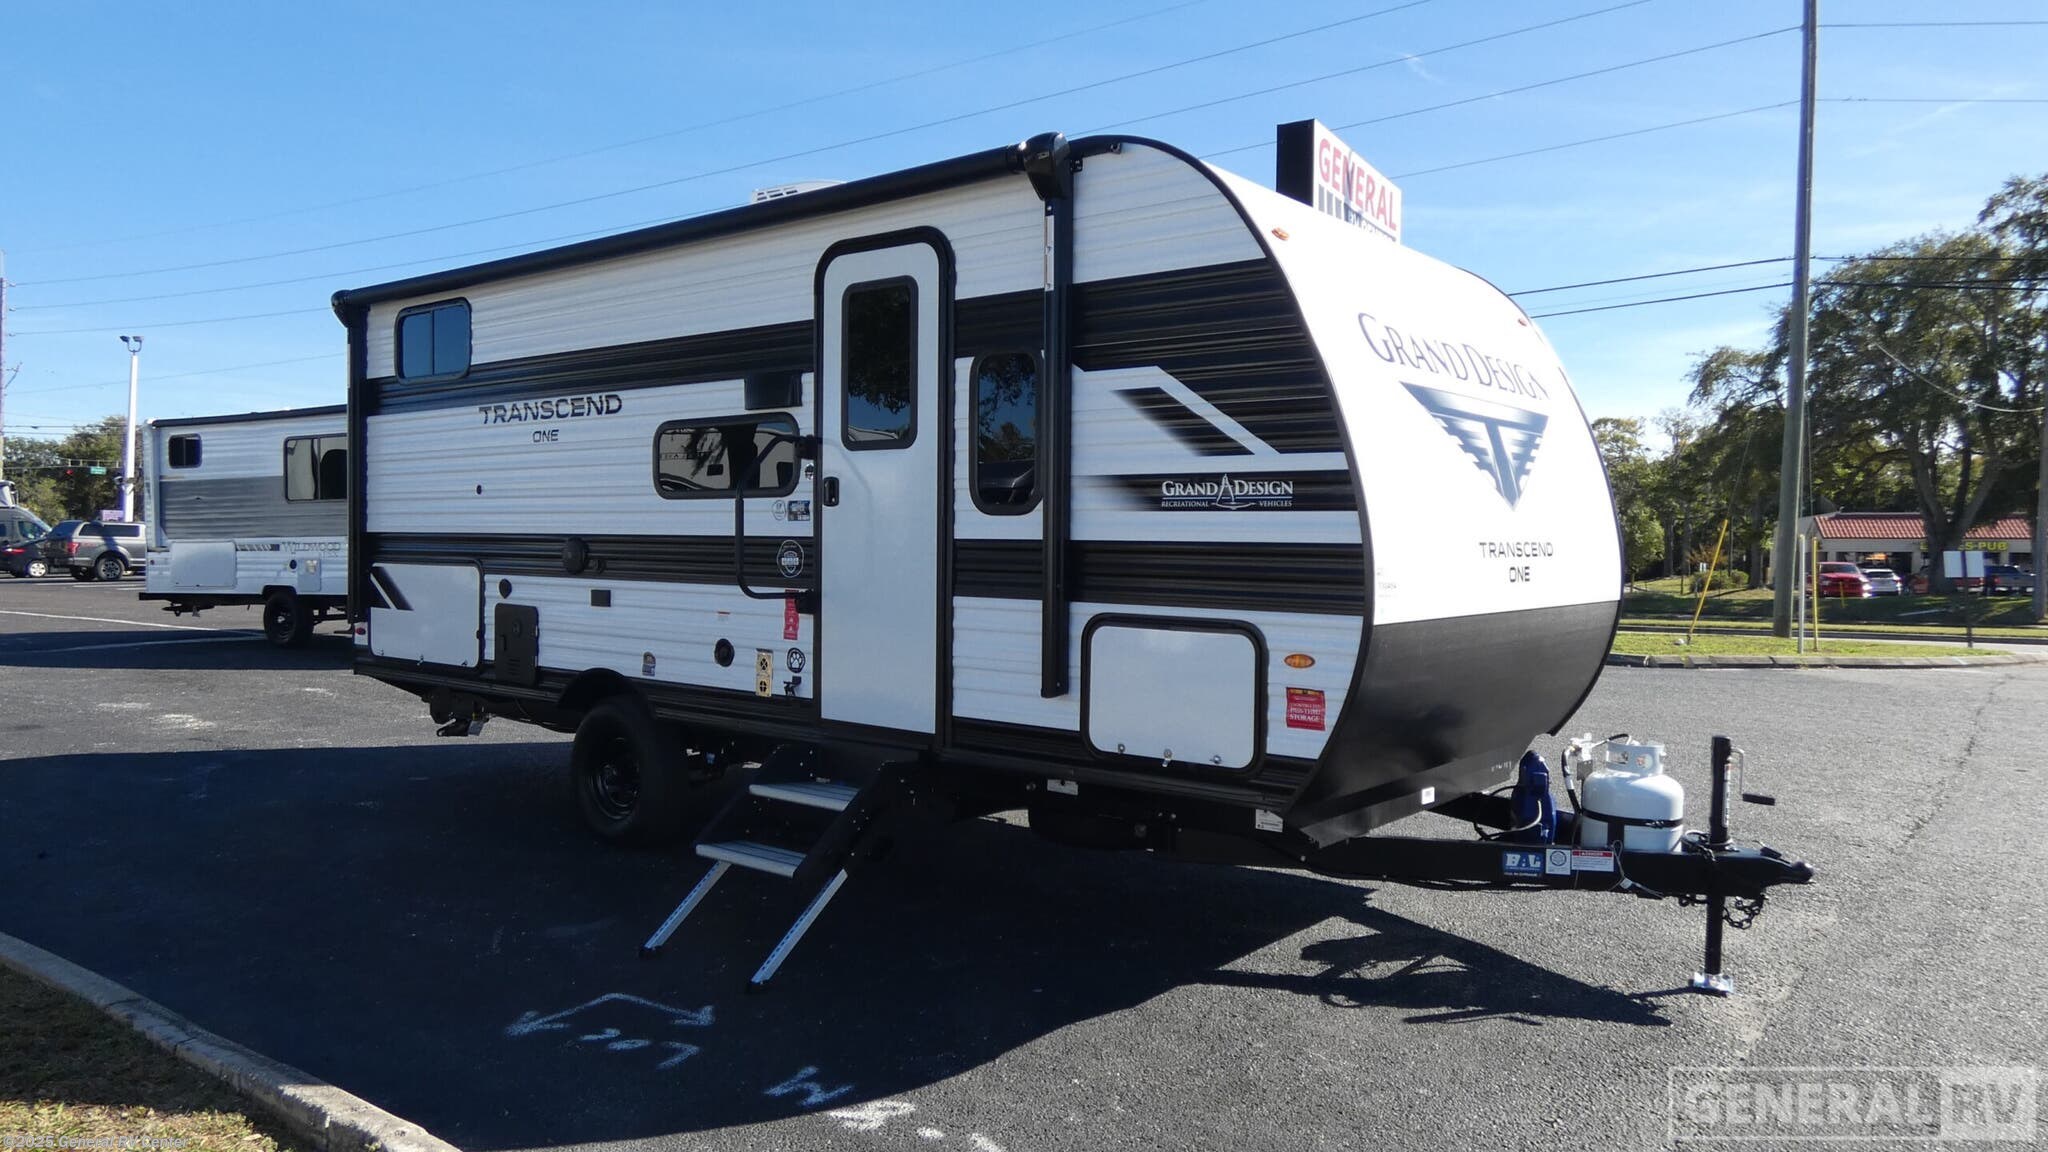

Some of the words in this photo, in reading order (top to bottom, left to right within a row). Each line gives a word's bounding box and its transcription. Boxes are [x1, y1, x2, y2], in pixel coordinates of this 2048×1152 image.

[1319, 138, 1397, 231] GENERAL
[1358, 313, 1469, 381] GRAND
[1461, 343, 1550, 400] DESIGN
[478, 393, 623, 425] TRANSCEND
[532, 429, 560, 443] ONE
[1161, 480, 1219, 497] GRAND
[1233, 479, 1294, 496] DESIGN
[1161, 500, 1209, 508] RECREATIONAL
[1259, 500, 1293, 508] VEHICLES
[1479, 541, 1554, 558] TRANSCEND
[1509, 566, 1530, 583] ONE
